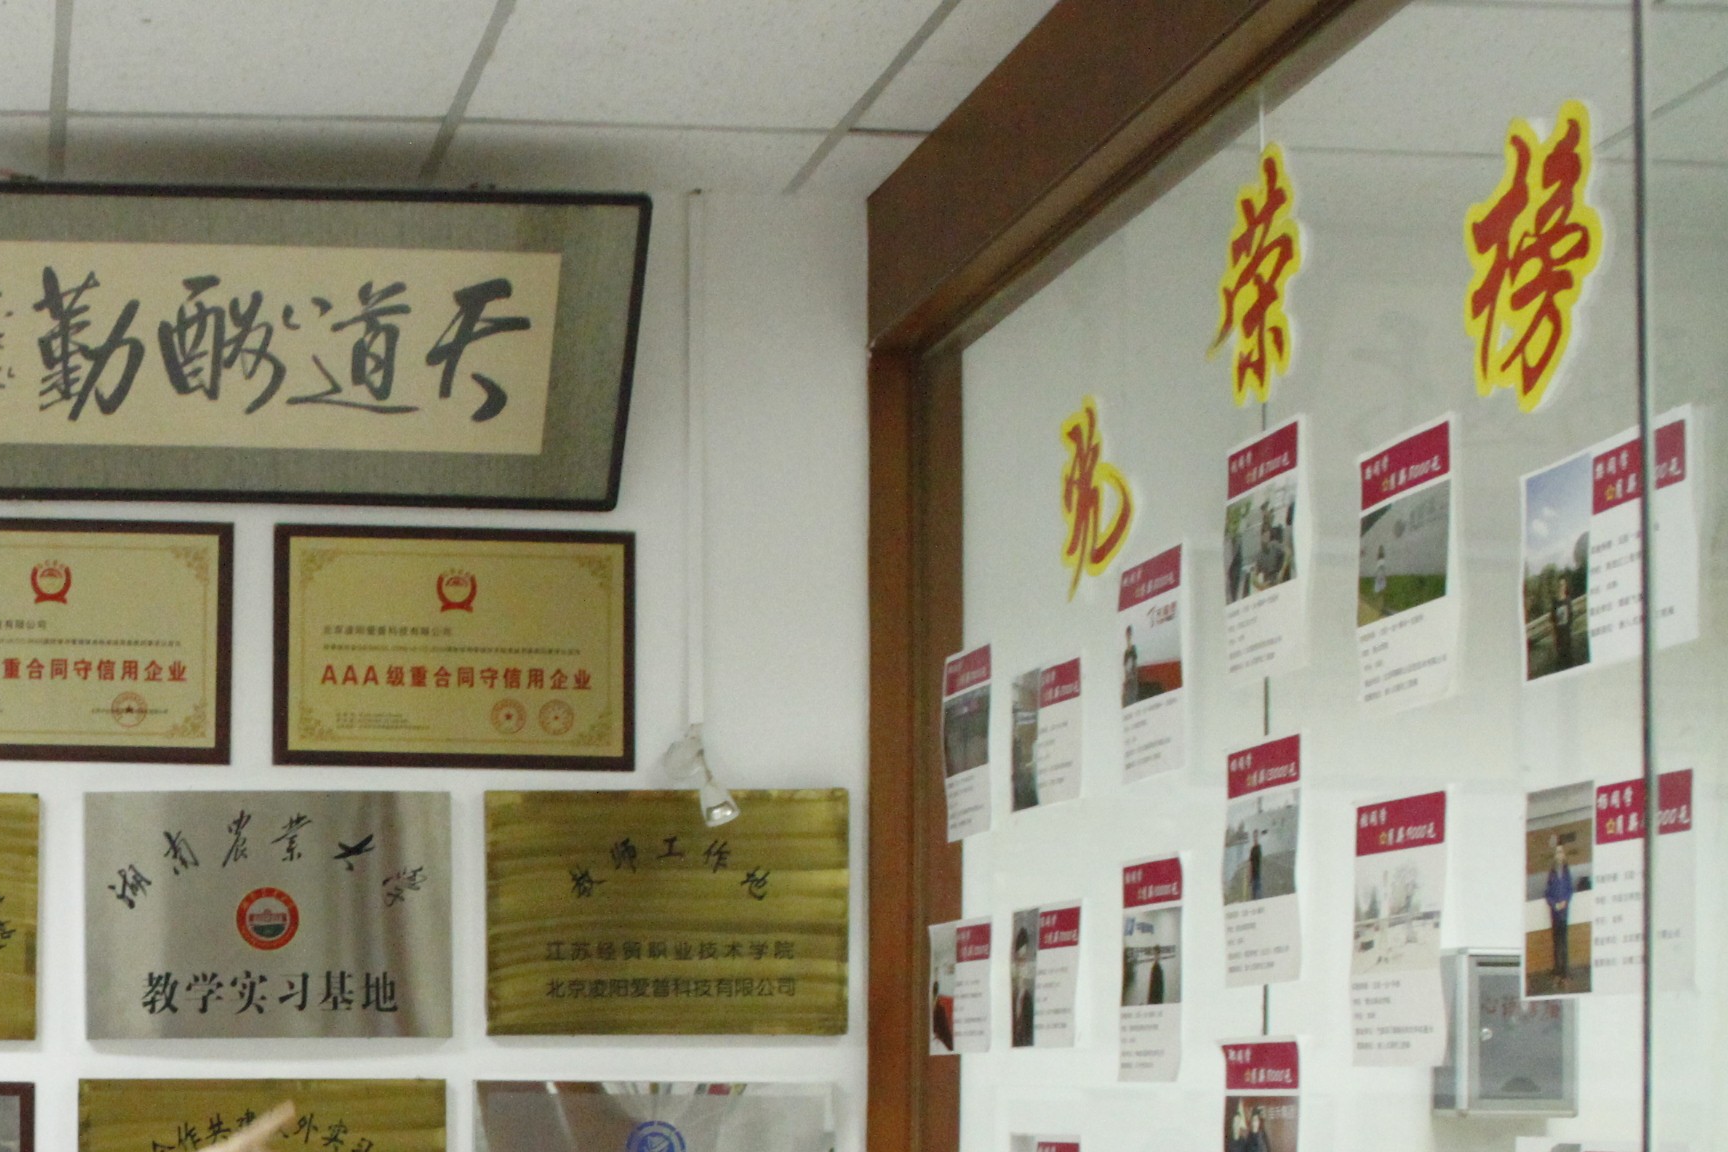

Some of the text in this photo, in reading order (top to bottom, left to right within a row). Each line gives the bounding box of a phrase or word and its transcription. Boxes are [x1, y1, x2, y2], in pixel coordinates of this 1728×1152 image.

[33, 266, 532, 423] 天道酬勤
[321, 664, 593, 690] AAA级重合同守信用企业
[544, 939, 795, 961] 江苏经贸职业技术学院
[142, 969, 399, 1015] 教学实习基地
[545, 976, 797, 999] 北京凌阳爱普科技有限公司
